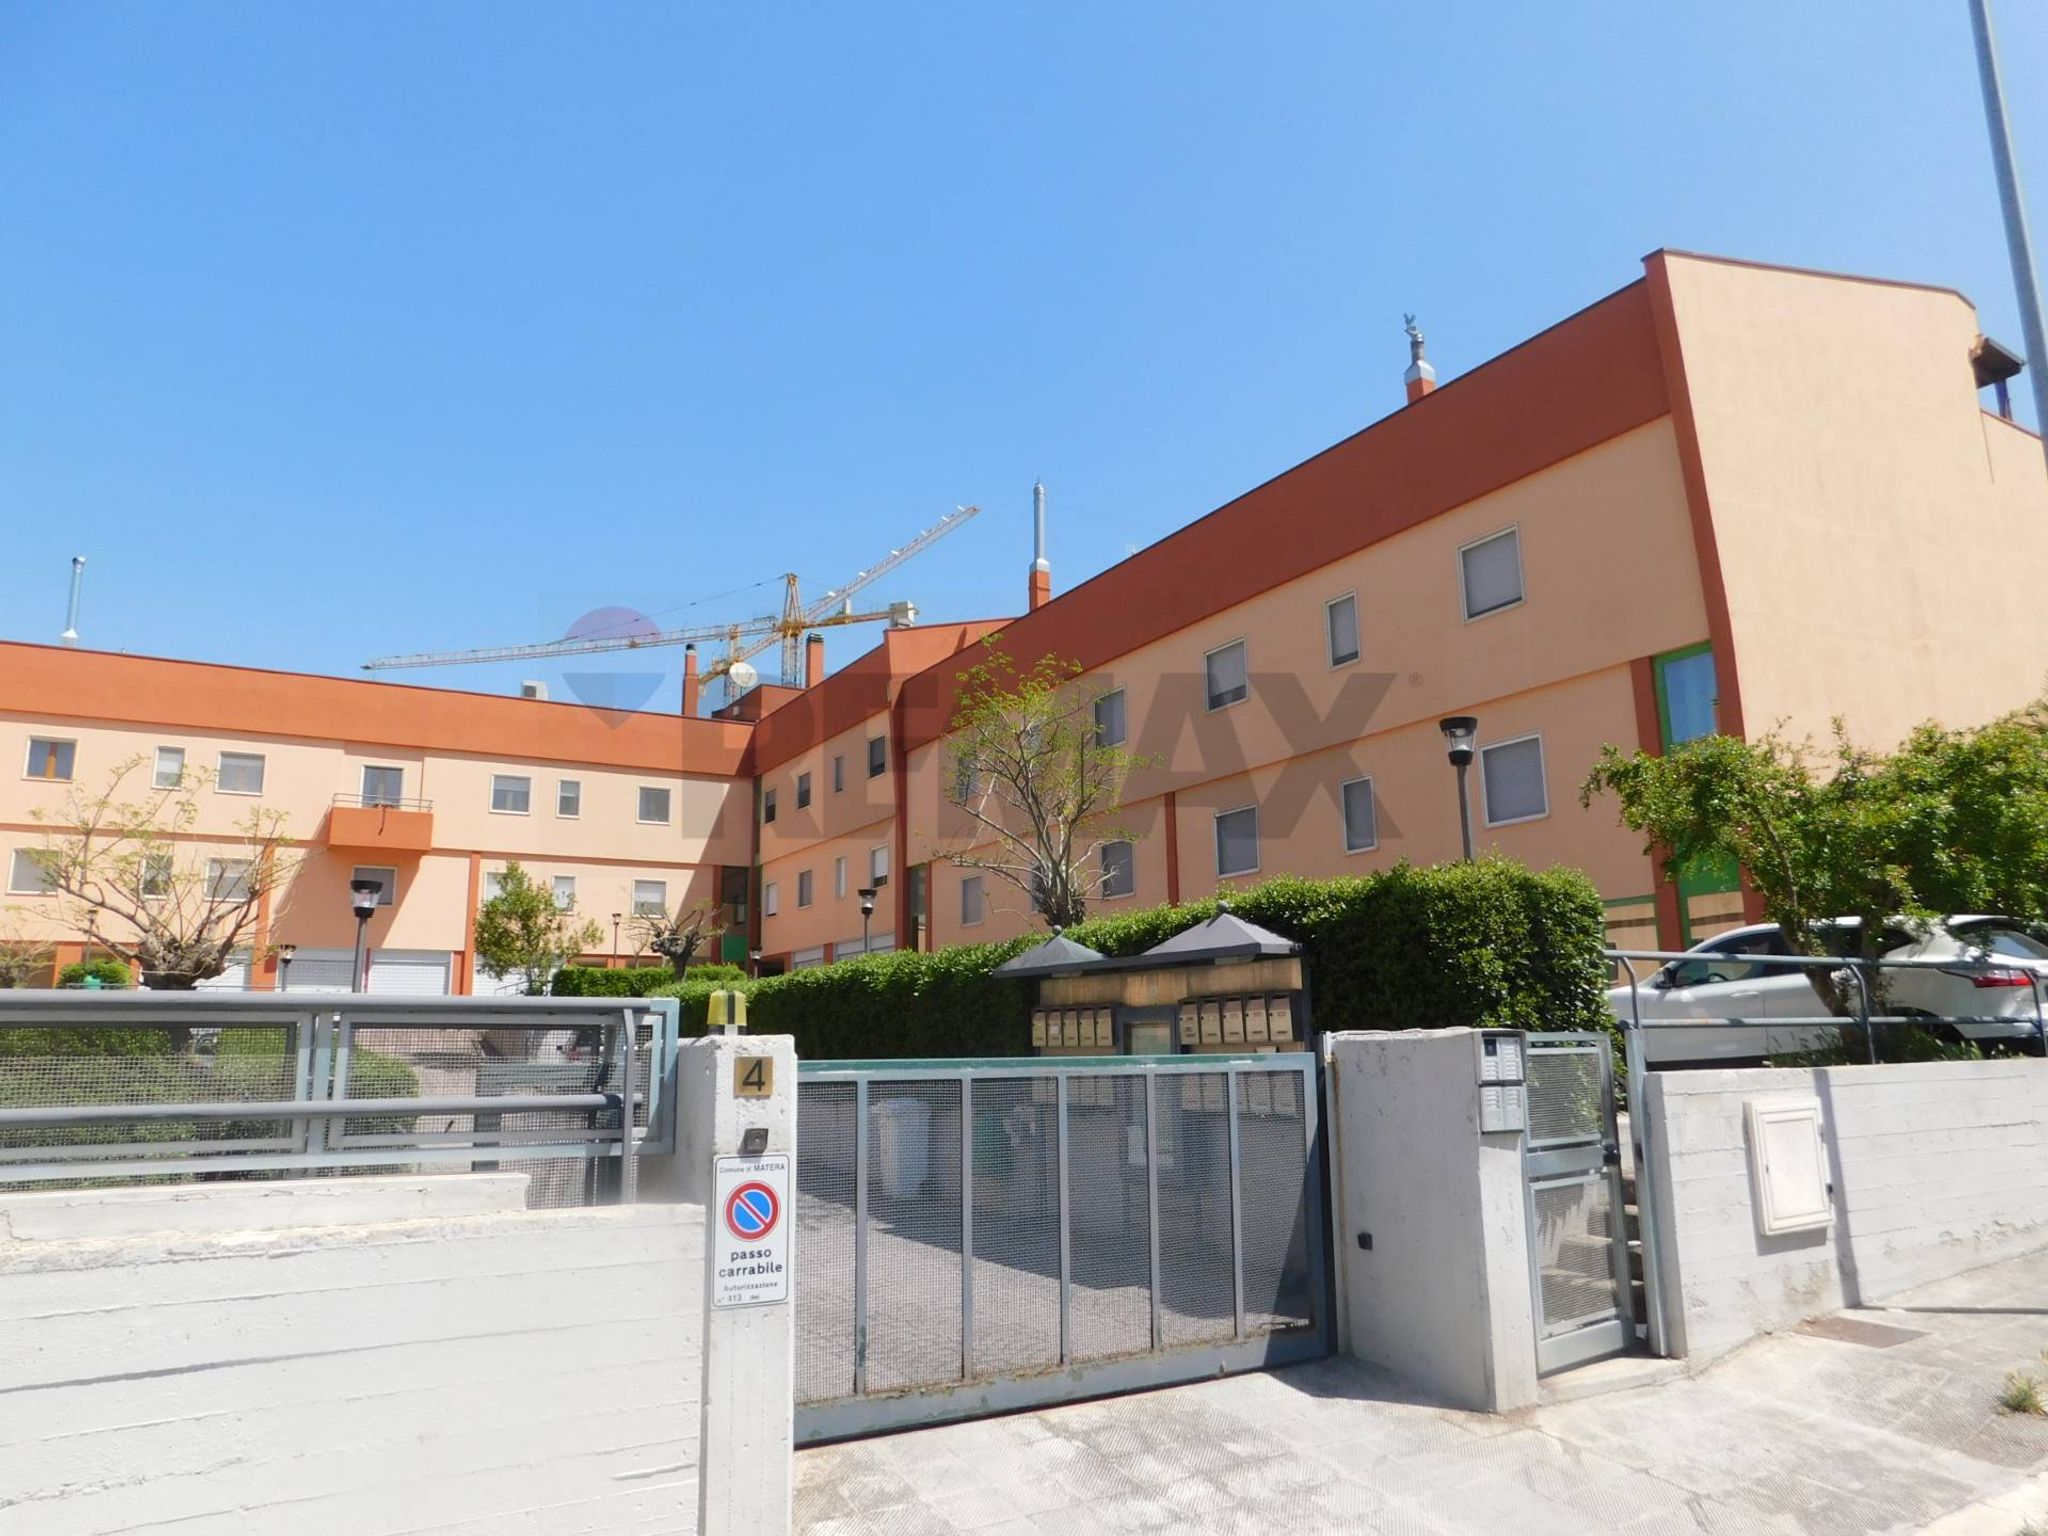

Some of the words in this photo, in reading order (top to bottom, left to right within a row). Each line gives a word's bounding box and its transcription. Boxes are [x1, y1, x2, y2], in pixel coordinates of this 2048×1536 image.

[742, 1059, 765, 1091] 4
[753, 1162, 786, 1172] MATERA
[730, 1248, 772, 1263] passo
[718, 1261, 783, 1278] carrabile
